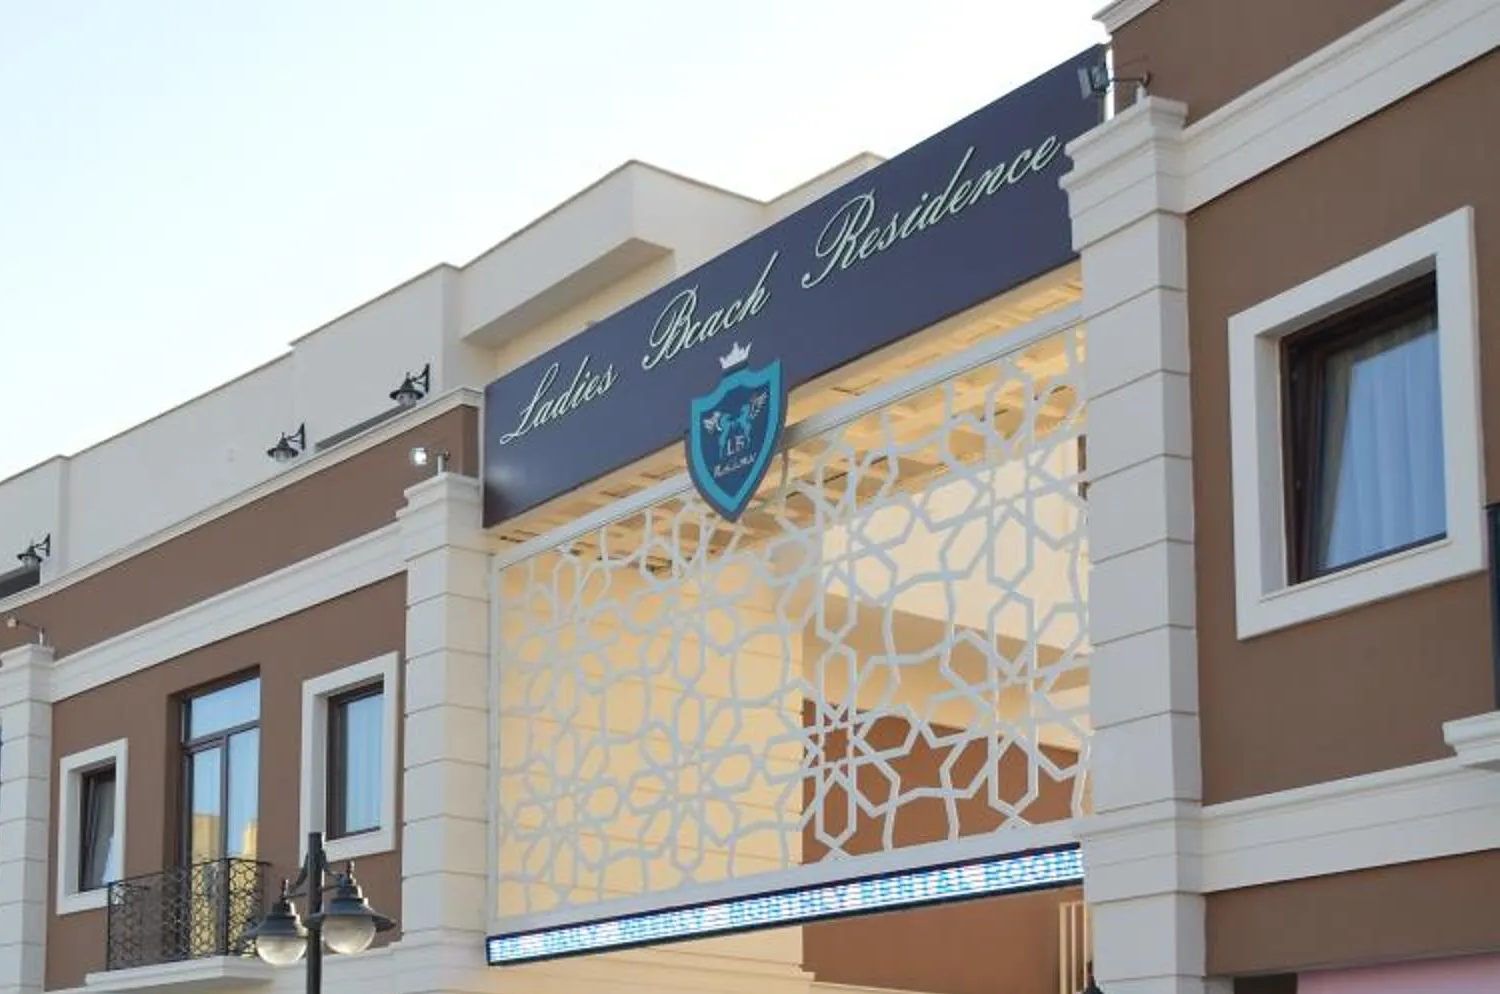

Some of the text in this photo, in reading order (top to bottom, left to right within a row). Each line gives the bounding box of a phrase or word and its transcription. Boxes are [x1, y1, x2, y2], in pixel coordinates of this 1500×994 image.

[499, 134, 1061, 445] Ladies Beach Residence
